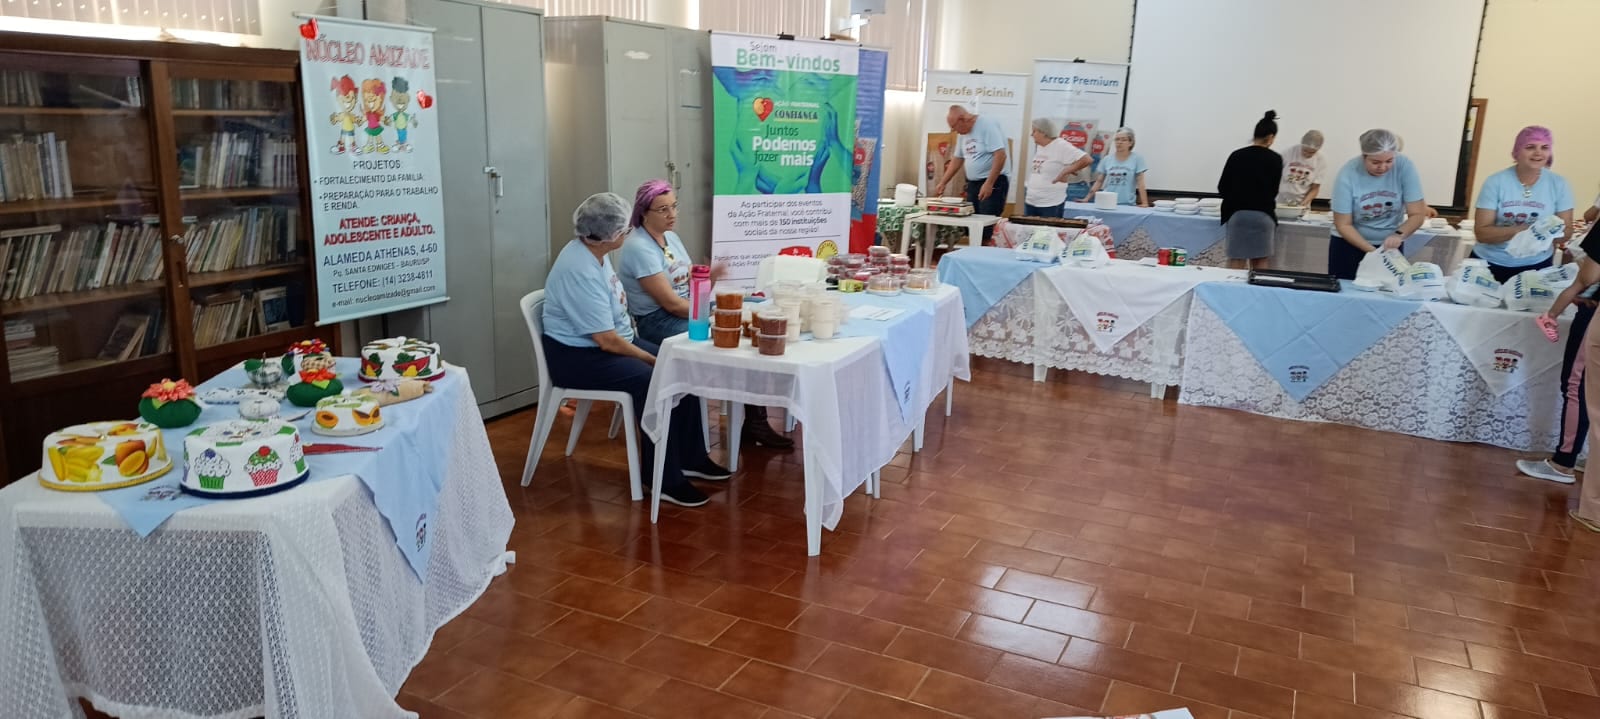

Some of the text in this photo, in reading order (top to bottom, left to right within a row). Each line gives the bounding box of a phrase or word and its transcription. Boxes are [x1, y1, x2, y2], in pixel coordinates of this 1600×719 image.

[306, 33, 366, 65] NÚCLEO
[736, 48, 840, 72] Bem-vindos
[1040, 75, 1119, 87] Arroz Premium
[936, 86, 1014, 98] Farofa Picinin
[765, 124, 799, 138] Juntos
[752, 136, 817, 151] Podemos
[754, 150, 815, 166] fazer mais
[319, 174, 385, 186] FORTALECIMENTO
[387, 173, 397, 182] DA
[323, 186, 439, 200] PREPARAÇÃO PARA O TRABALHO
[324, 202, 330, 211] E
[752, 200, 785, 209] participar
[339, 212, 420, 229] ATENDE: CRIANÇA,
[324, 224, 435, 246] ADOLESCENTE E ADULTO.
[323, 250, 373, 266] ALAMEDA
[374, 245, 418, 259] ATHENAS,
[345, 266, 367, 276] SANTA
[332, 278, 380, 294] TELEFONE:
[382, 276, 396, 287] (14)
